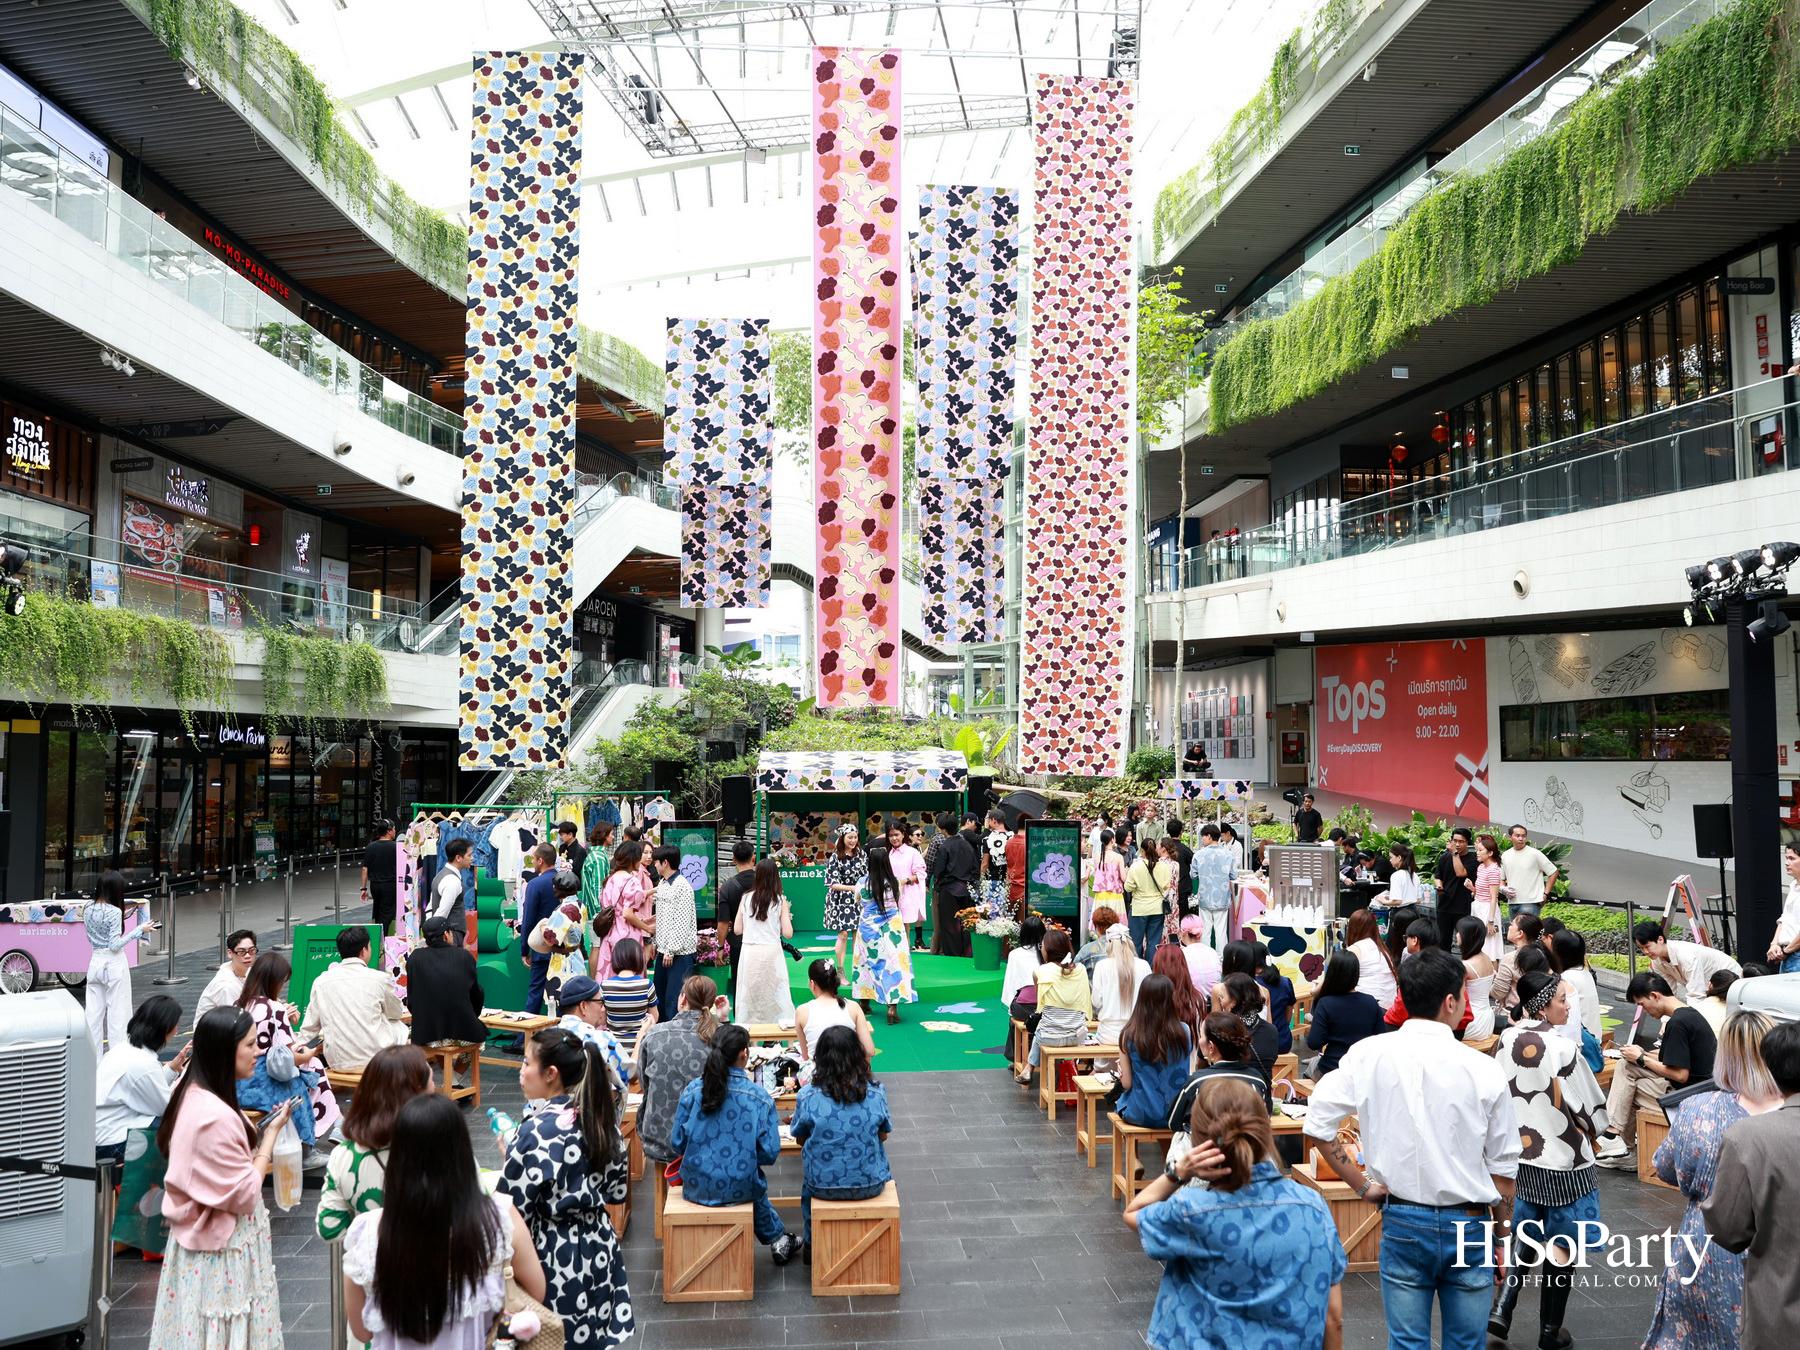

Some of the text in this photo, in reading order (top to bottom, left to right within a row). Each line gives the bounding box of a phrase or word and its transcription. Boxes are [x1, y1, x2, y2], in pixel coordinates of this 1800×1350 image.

[205, 227, 290, 299] MO-MO-PARADISE
[1726, 281, 1765, 292] Hong Bao
[13, 416, 43, 442] ทอง
[115, 461, 149, 470] THONG SMITH
[577, 597, 617, 618] JAROEN
[1407, 675, 1467, 697] เปิดบริการทุกวัน
[1321, 675, 1386, 734] Tops
[1417, 702, 1457, 719] Open daily
[219, 724, 265, 745] Lemon Farm
[1415, 725, 1432, 739] 9.00
[1438, 724, 1460, 738] 22.00
[1327, 743, 1382, 755] #EveryDayDISCOVERY
[779, 869, 826, 878] arimek
[19, 927, 69, 936] marimekko
[41, 1163, 60, 1174] MEGA
